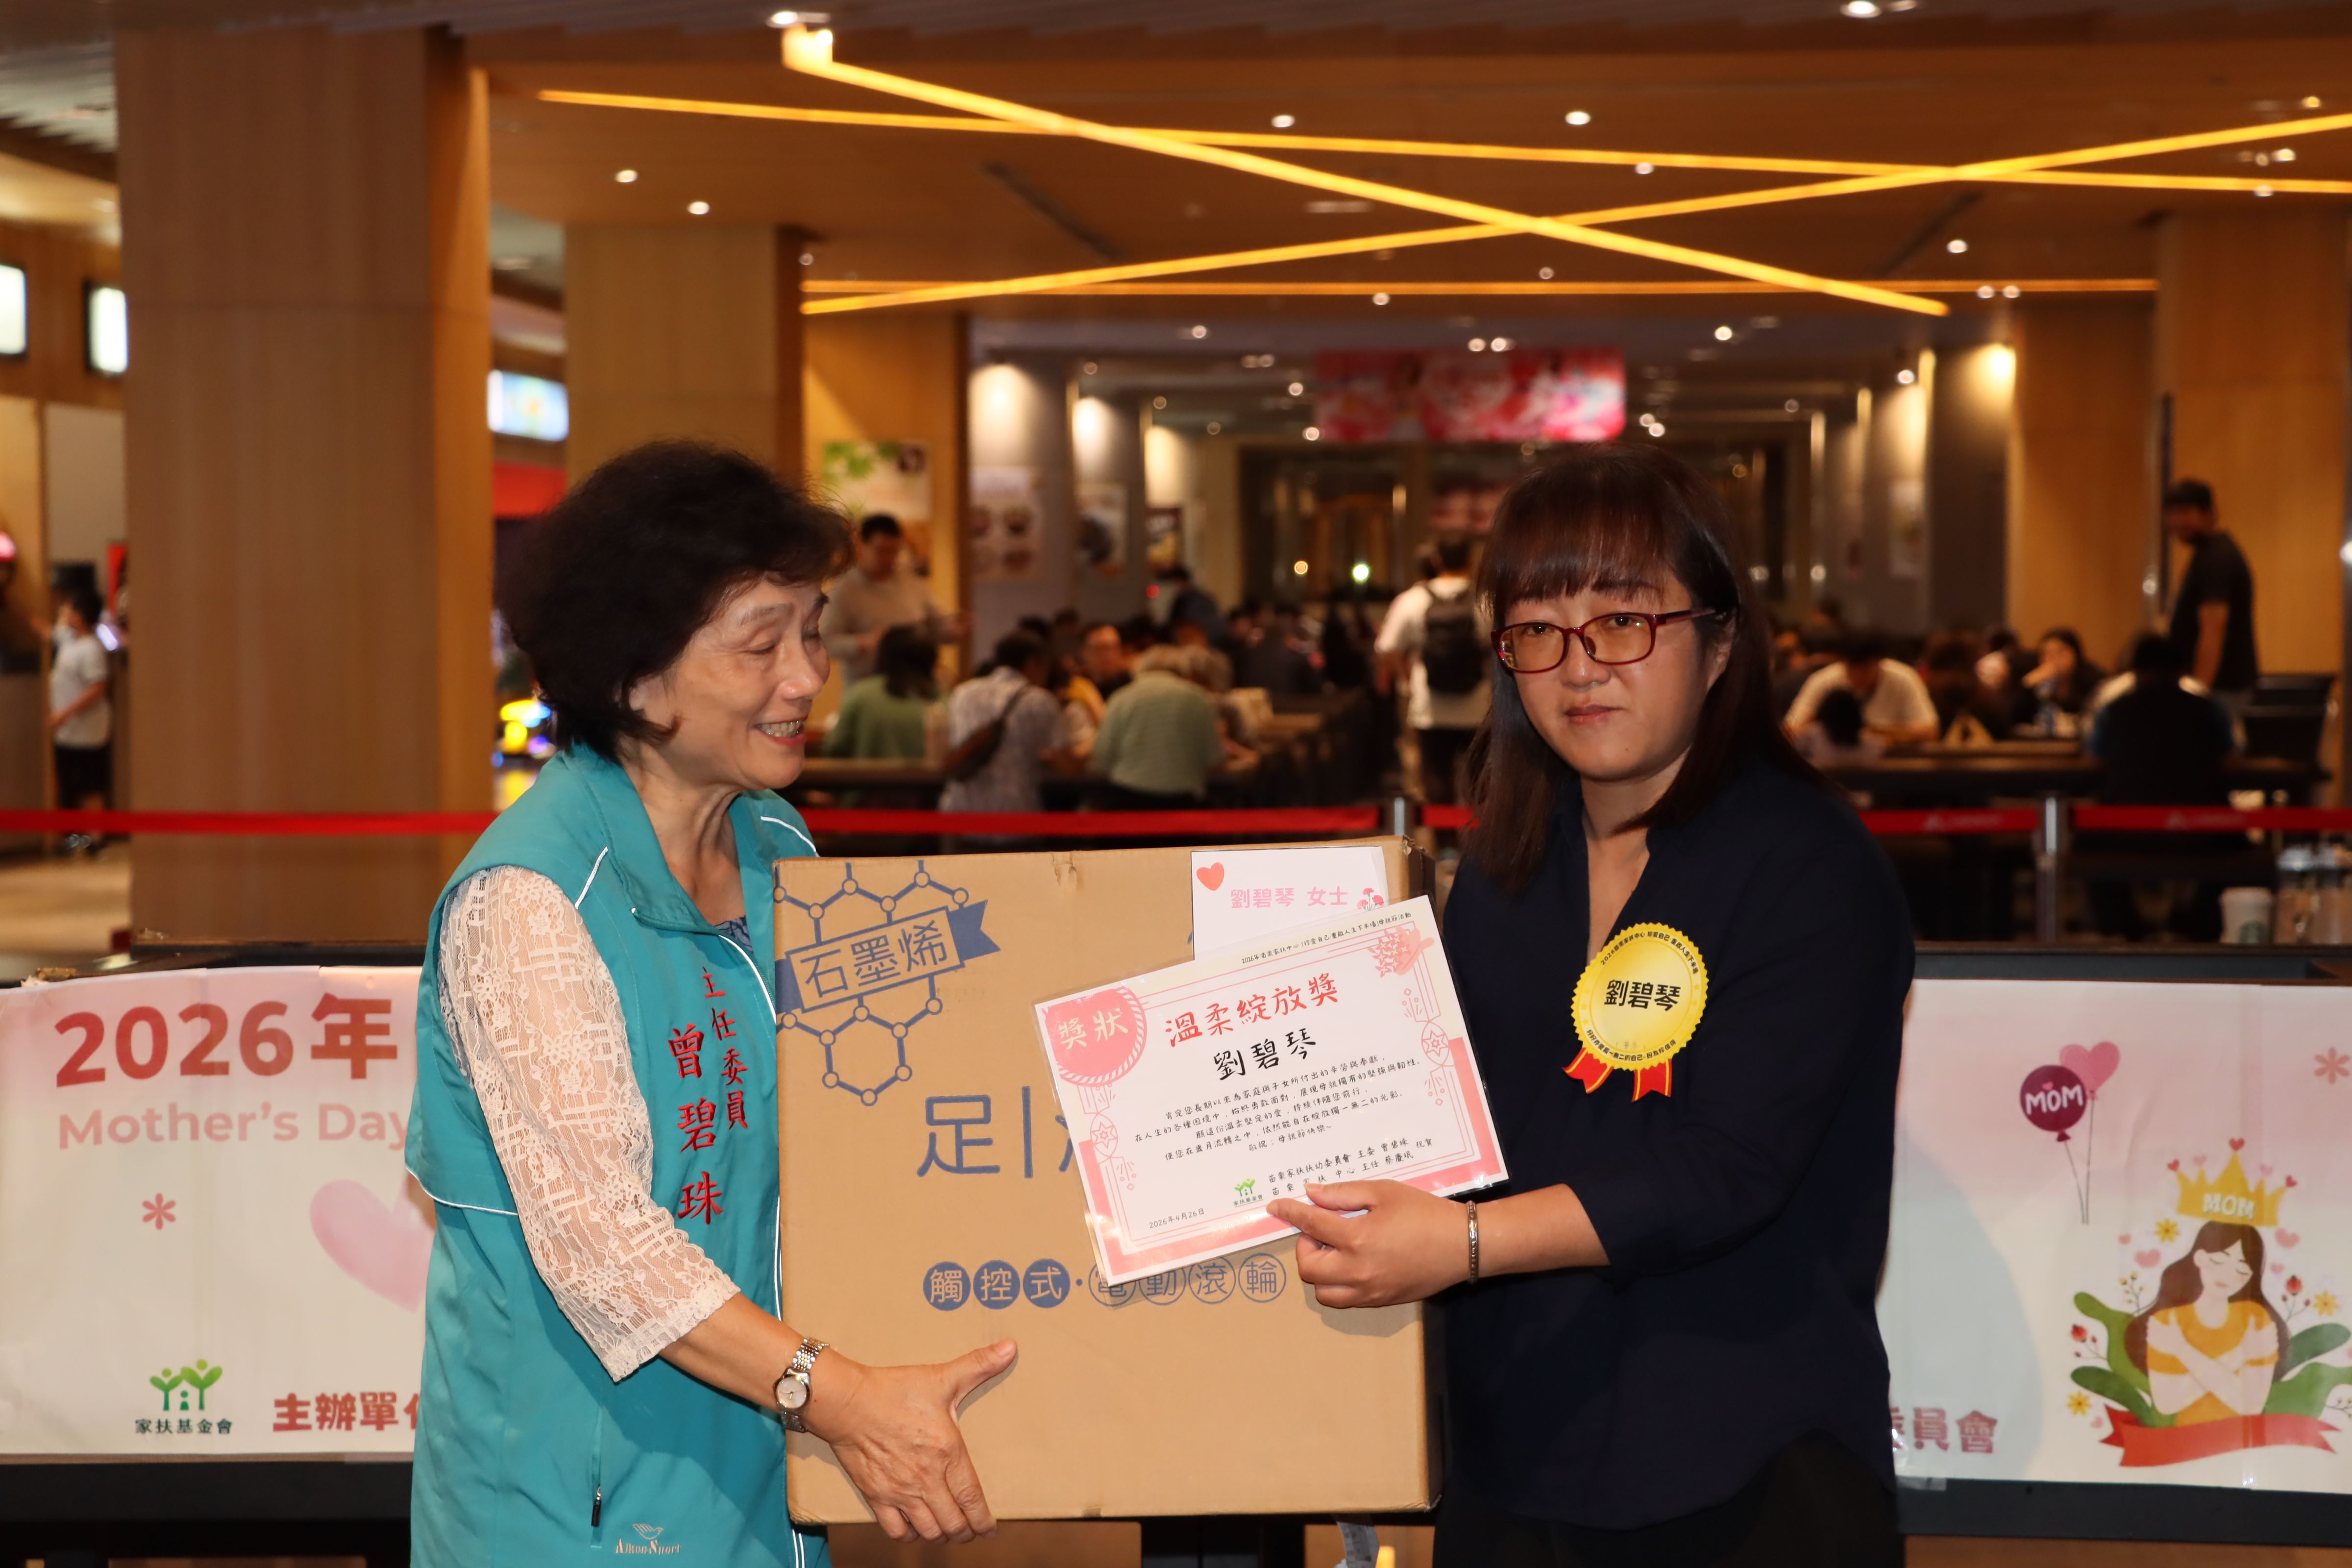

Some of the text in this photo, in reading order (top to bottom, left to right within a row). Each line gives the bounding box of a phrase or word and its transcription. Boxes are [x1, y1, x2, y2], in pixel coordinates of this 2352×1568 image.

[1231, 886, 1348, 909] 劉碧琴 女士
[800, 919, 948, 998] 石墨烯
[1165, 973, 1339, 1047] 溫柔綻放獎
[1604, 980, 1681, 1011] 劉碧琴
[54, 992, 397, 1087] 2026年
[1057, 1007, 1129, 1050] 獎狀
[702, 966, 748, 1130] 主任委員
[1213, 1027, 1317, 1081] 劉碧琴
[2024, 1083, 2084, 1115] MOM
[59, 1102, 407, 1151] Mother's Day
[667, 1023, 724, 1225] 曾碧珠
[1357, 1146, 1375, 1159] 主委
[1362, 1160, 1380, 1172] 主任
[1150, 1208, 1204, 1229] 2026年4月26日
[2202, 1192, 2256, 1220] MOM
[134, 1418, 233, 1435] 家扶基金會
